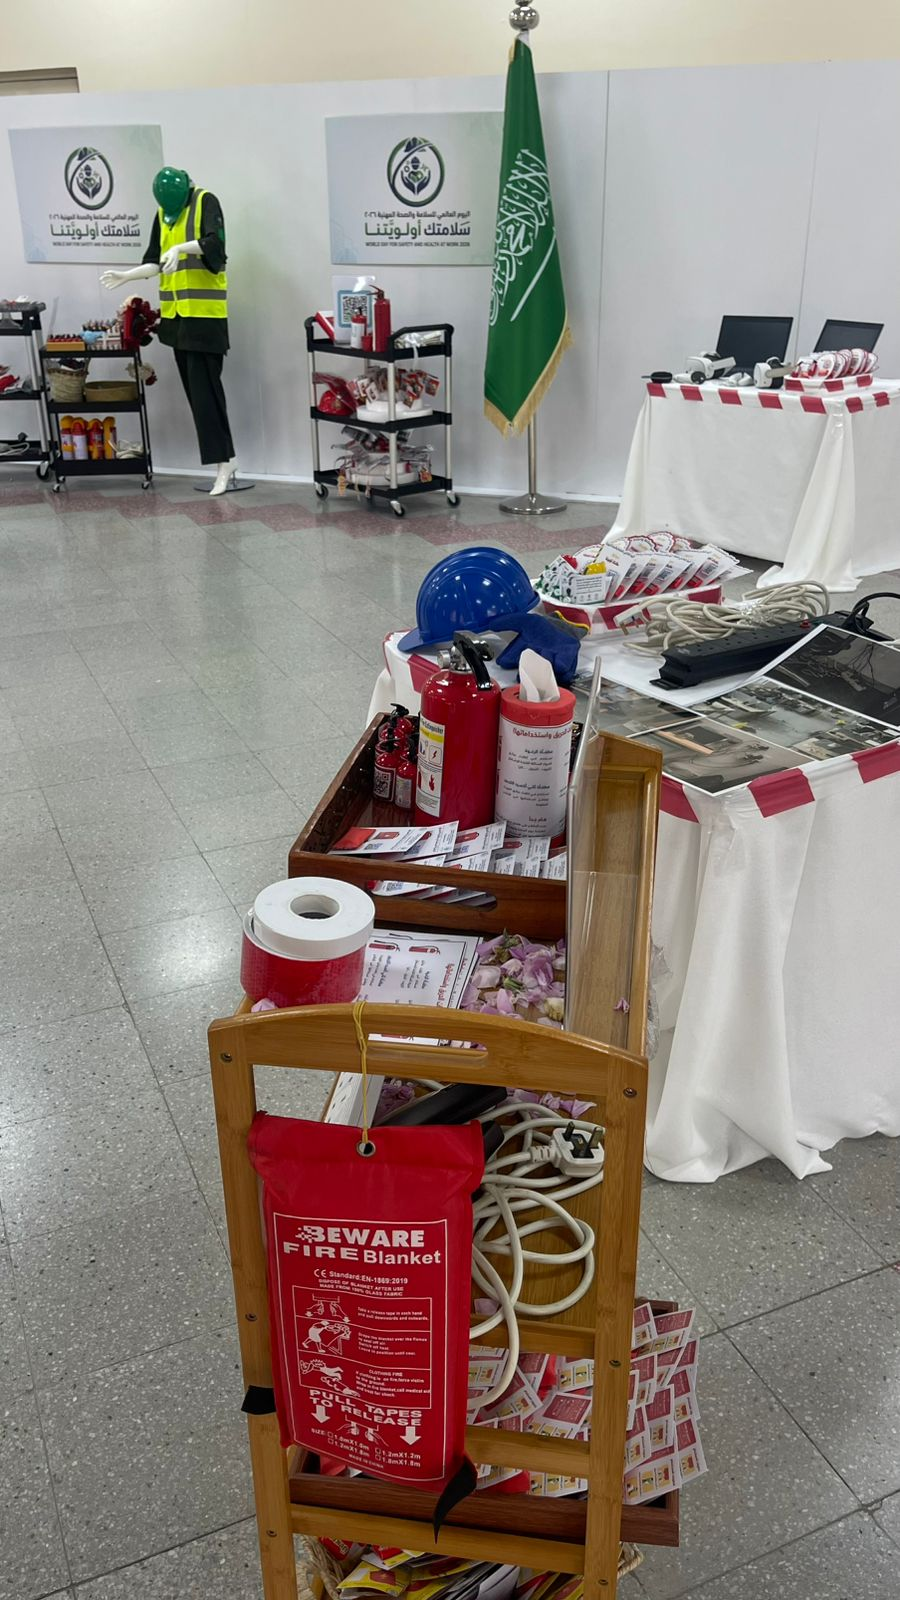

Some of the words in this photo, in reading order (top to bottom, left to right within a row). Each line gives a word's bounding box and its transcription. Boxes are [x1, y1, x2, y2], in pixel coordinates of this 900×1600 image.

[377, 211, 395, 219] المهنية
[397, 211, 415, 219] والصحة
[437, 211, 456, 220] العالمي
[457, 211, 470, 219] اليوم
[296, 1225, 425, 1248] BEWARE
[283, 1241, 359, 1261] FIRE
[363, 1249, 441, 1265] Blanket
[369, 1369, 392, 1377] CLOTHING
[309, 1389, 356, 1407] PULL
[365, 1404, 422, 1418] TAPES
[309, 1396, 334, 1408] TO
[341, 1405, 422, 1427] RELEASE
